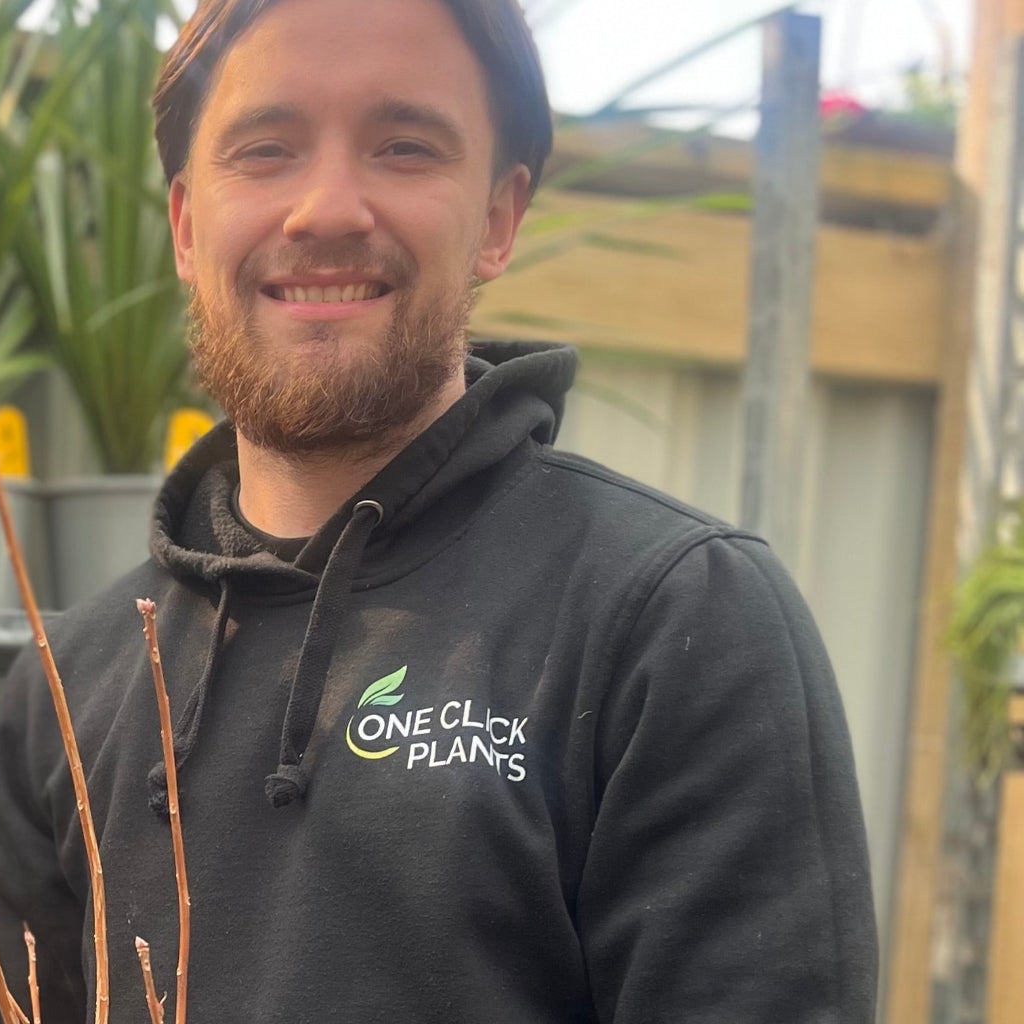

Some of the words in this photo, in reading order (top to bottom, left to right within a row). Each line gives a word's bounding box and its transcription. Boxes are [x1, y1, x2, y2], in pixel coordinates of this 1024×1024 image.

[357, 707, 434, 741] ONE
[440, 699, 528, 746] CLICK
[406, 735, 527, 782] PLANTS
